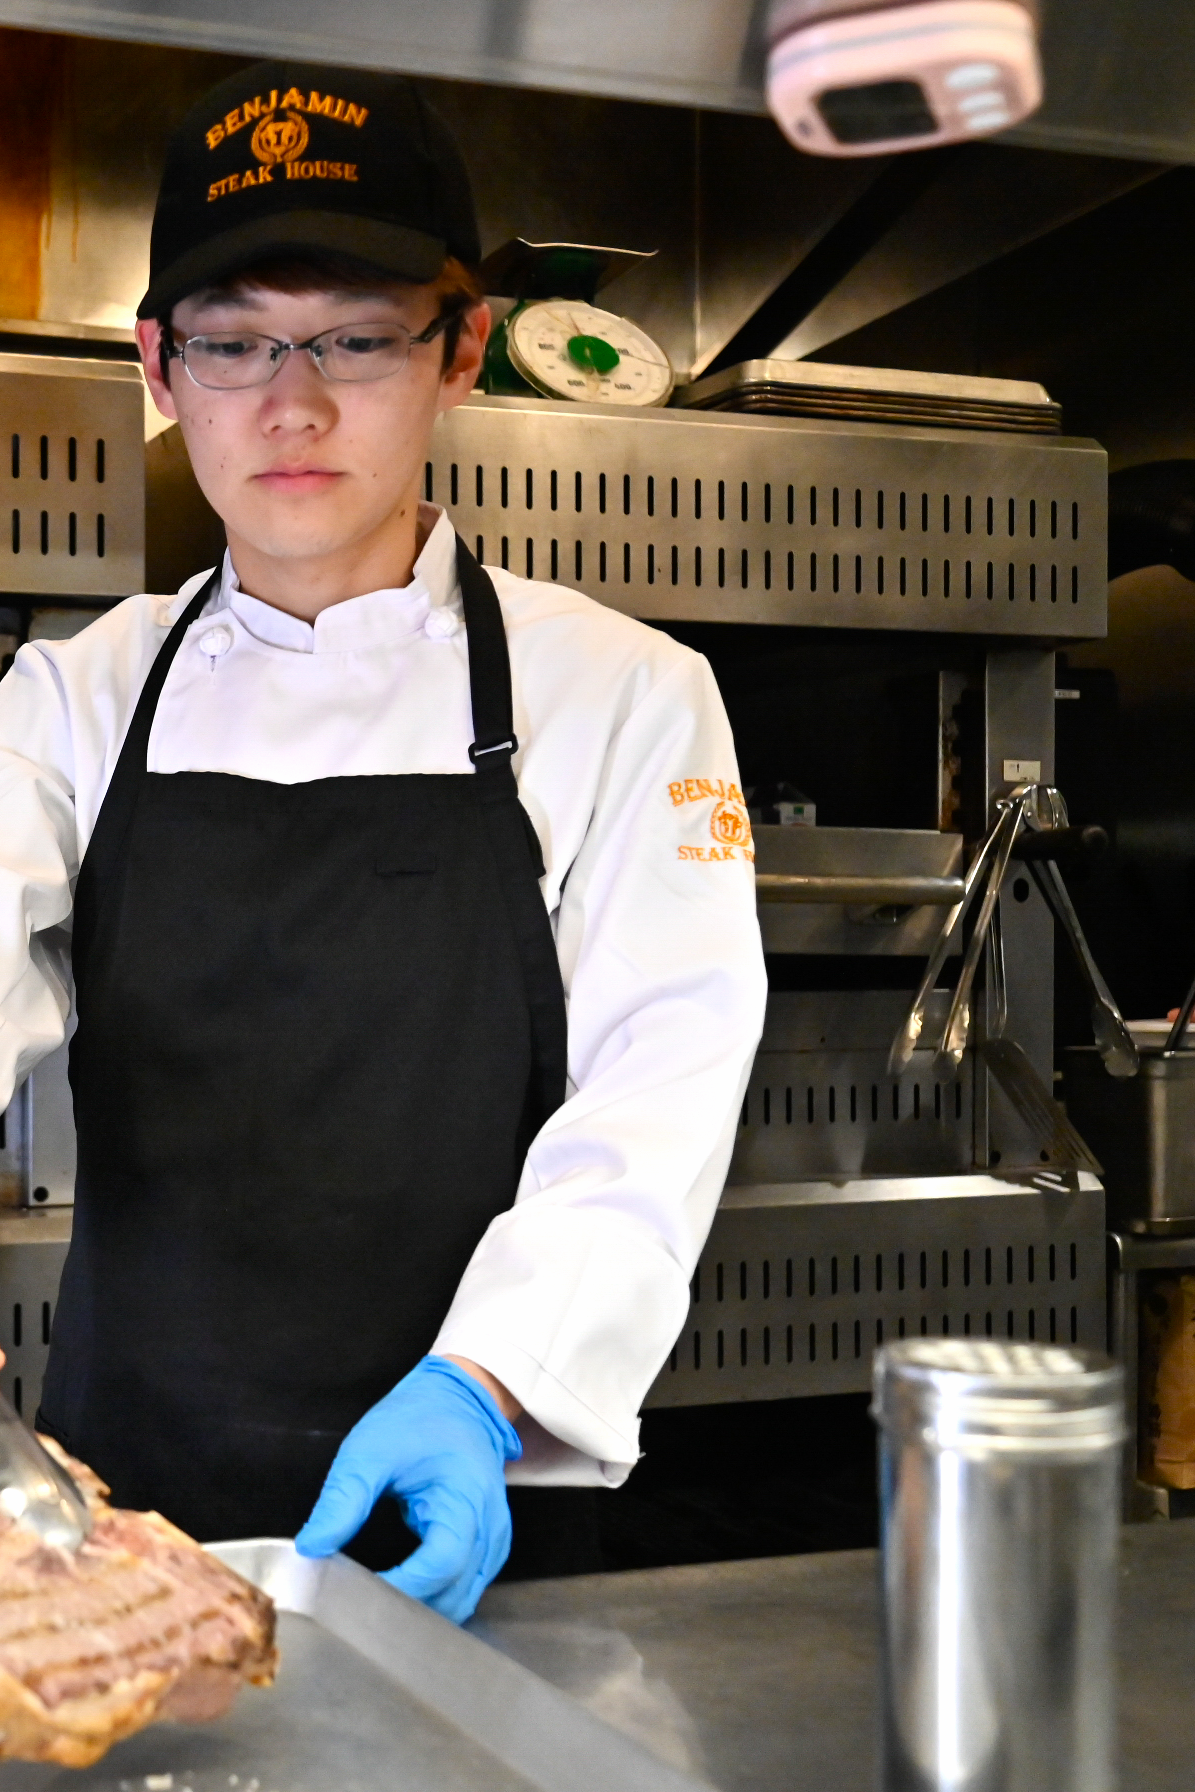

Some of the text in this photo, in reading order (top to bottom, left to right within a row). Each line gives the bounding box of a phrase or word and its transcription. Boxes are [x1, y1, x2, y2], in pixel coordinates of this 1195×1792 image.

[206, 87, 369, 150] BENJAMIN
[207, 160, 359, 202] STEAK HOUSE
[677, 845, 737, 862] STEAK
